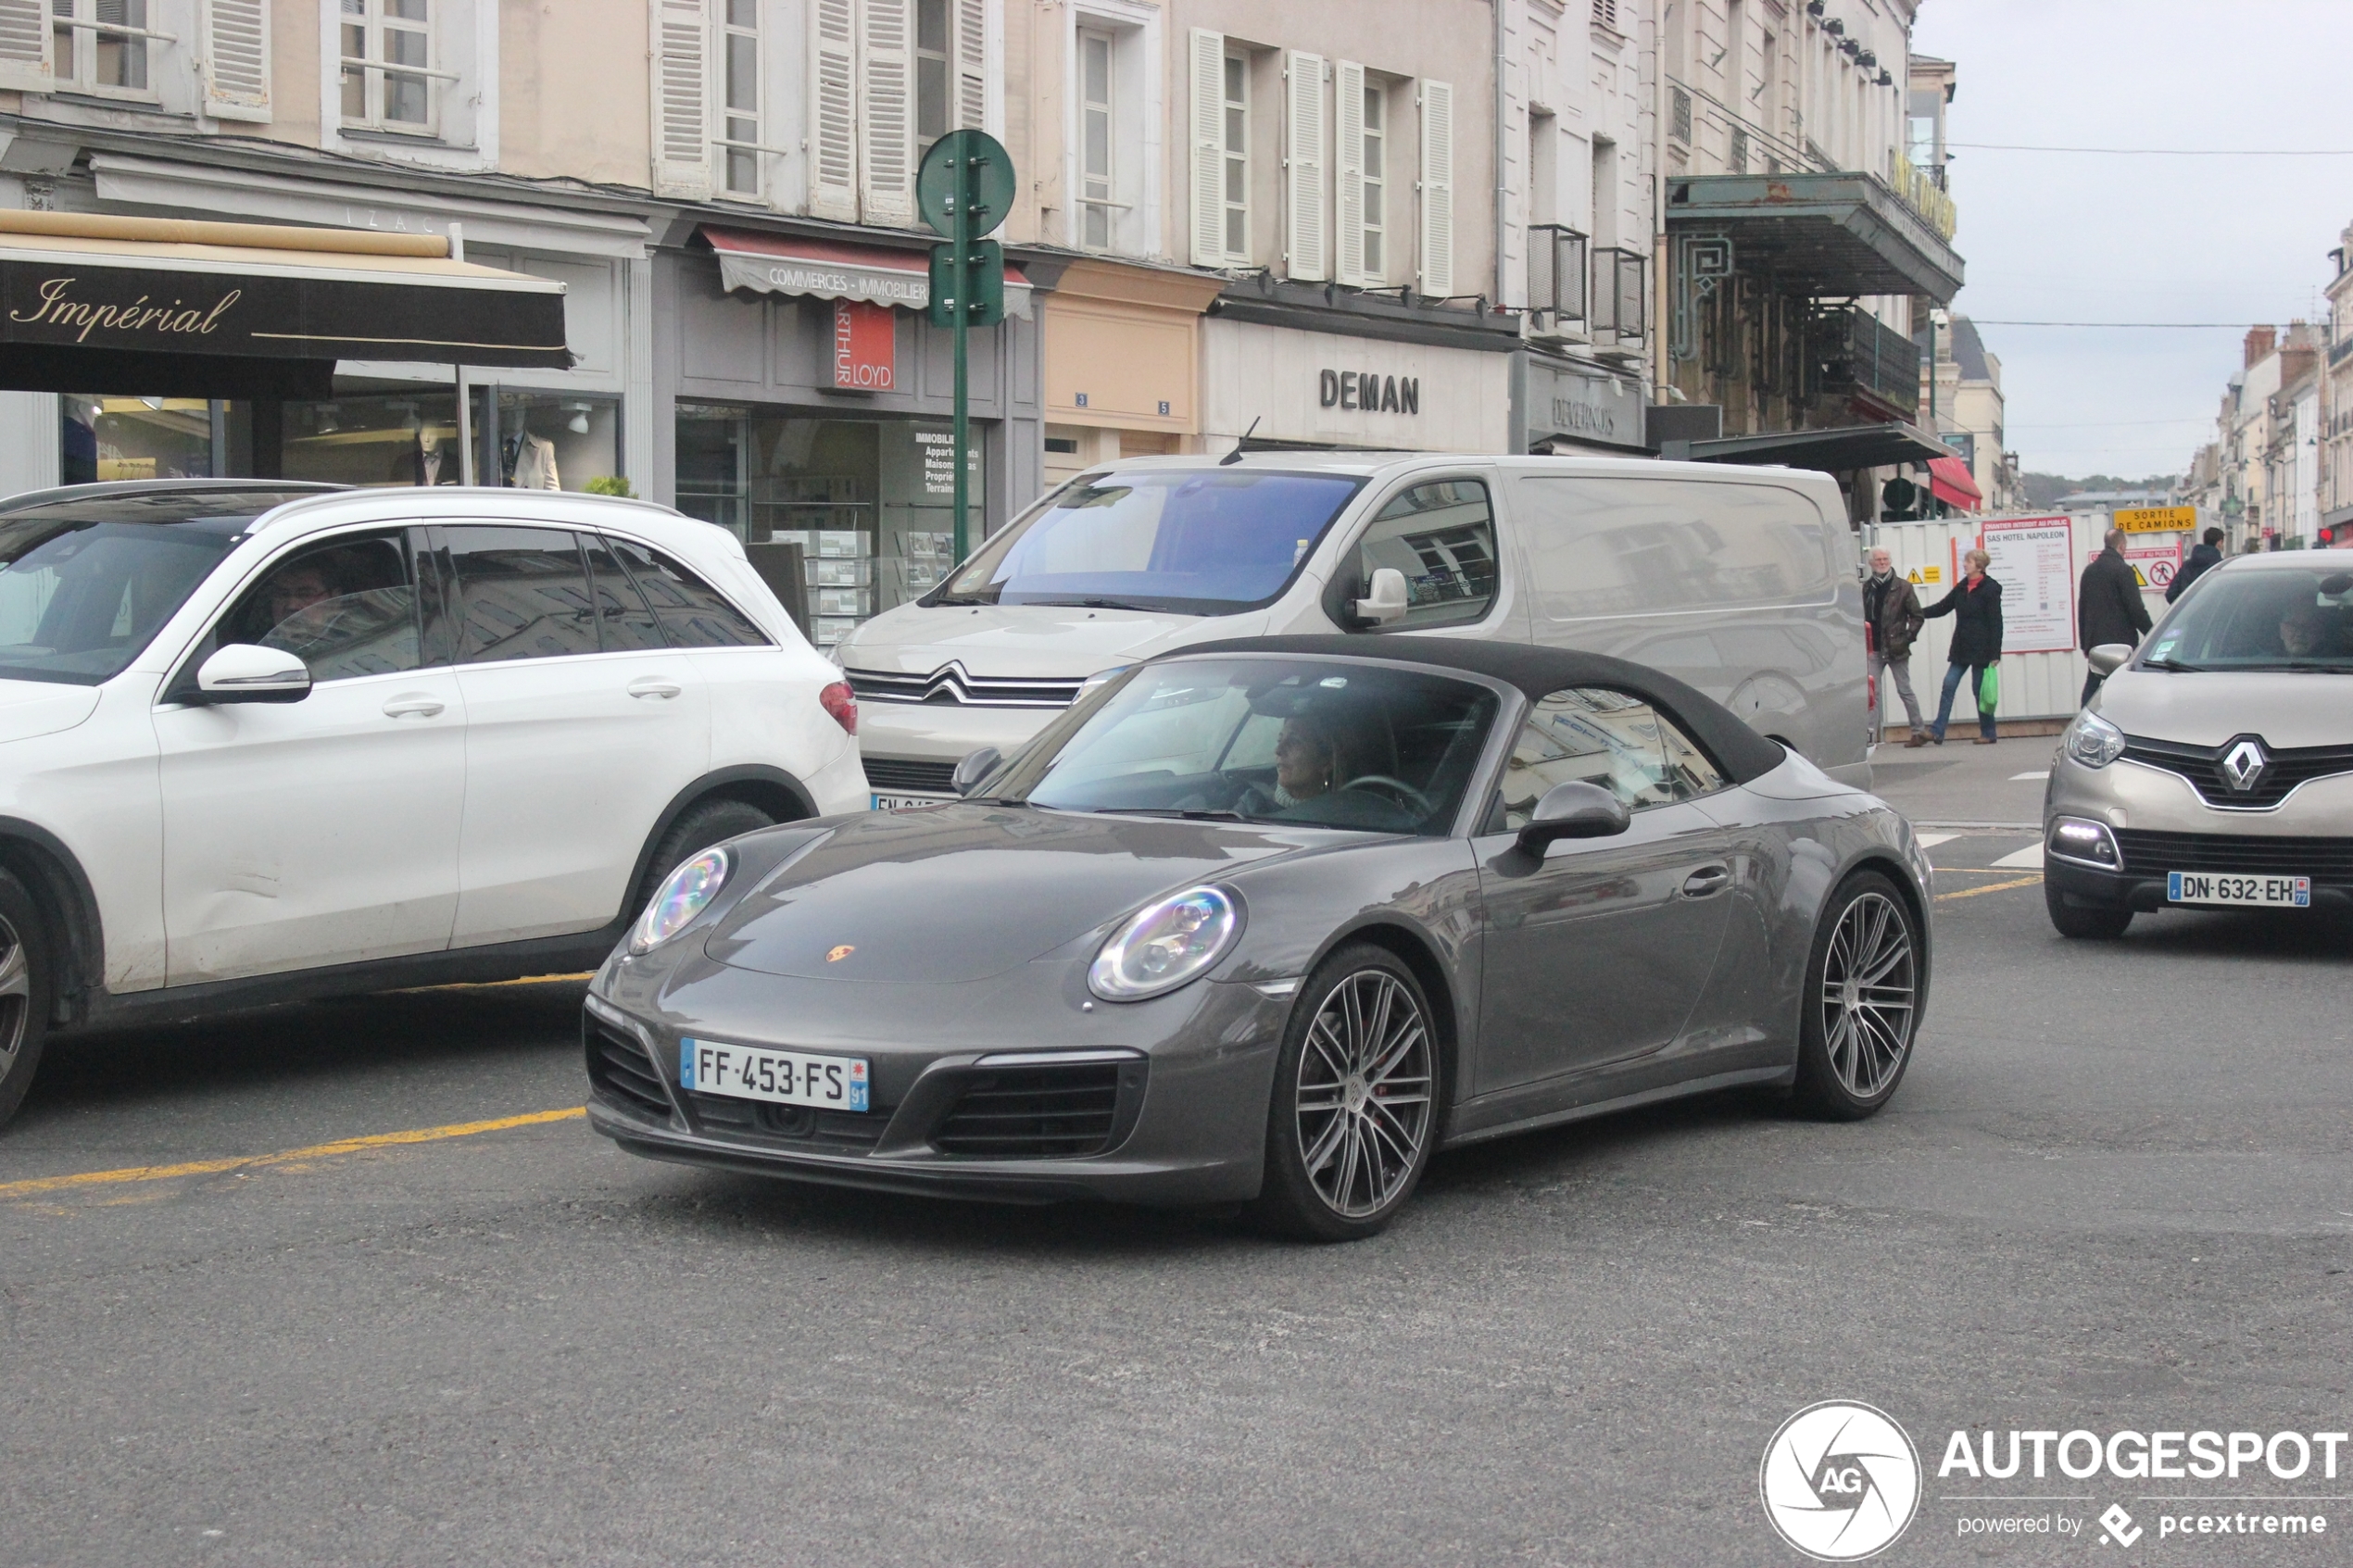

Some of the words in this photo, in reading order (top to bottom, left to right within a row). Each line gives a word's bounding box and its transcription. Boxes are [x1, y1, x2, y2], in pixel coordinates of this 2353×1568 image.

[346, 207, 433, 233] IZAC
[770, 268, 848, 291] COMMERCES
[859, 279, 927, 300] IMMOBILIER
[10, 278, 241, 343] Impérial
[837, 298, 851, 383] ARTHUR
[853, 364, 891, 387] LOYD
[1078, 395, 1085, 405] 3
[1321, 369, 1419, 415] DEMAN
[1161, 403, 1166, 413] 5
[915, 433, 955, 445] IMMOBILIE
[925, 470, 955, 483] Proprié
[2119, 521, 2133, 531] DE
[2139, 519, 2192, 529] CAMIONS
[2133, 509, 2175, 520] SORTIE
[1986, 534, 2001, 543] SAS
[2003, 533, 2025, 541] HOTEL
[2026, 531, 2065, 540] NAPOLEON
[2183, 877, 2293, 901] DN-632-EH
[2296, 893, 2308, 904] 77
[685, 1069, 690, 1079] F
[699, 1048, 843, 1100] FF-453-FS
[850, 1087, 867, 1105] 91
